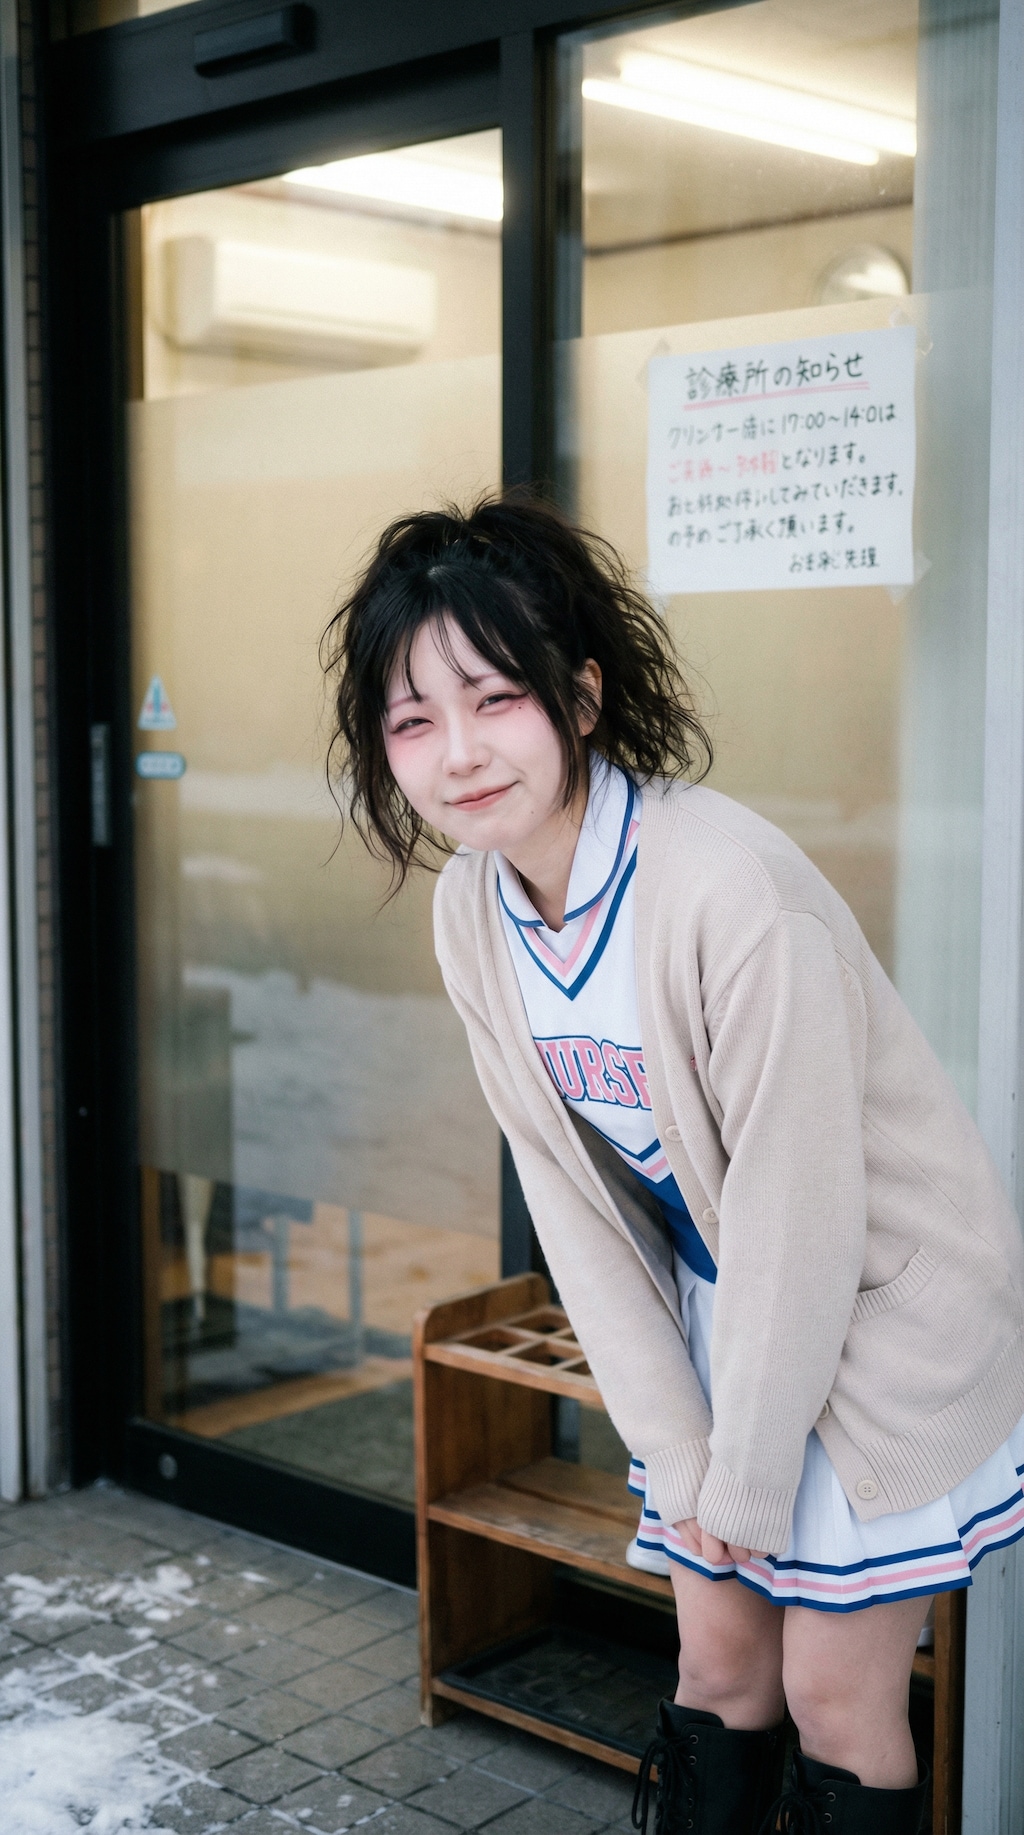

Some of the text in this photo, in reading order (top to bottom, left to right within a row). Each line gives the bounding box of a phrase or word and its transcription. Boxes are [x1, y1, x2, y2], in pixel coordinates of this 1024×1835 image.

[685, 352, 864, 400] 診療所の知らせ
